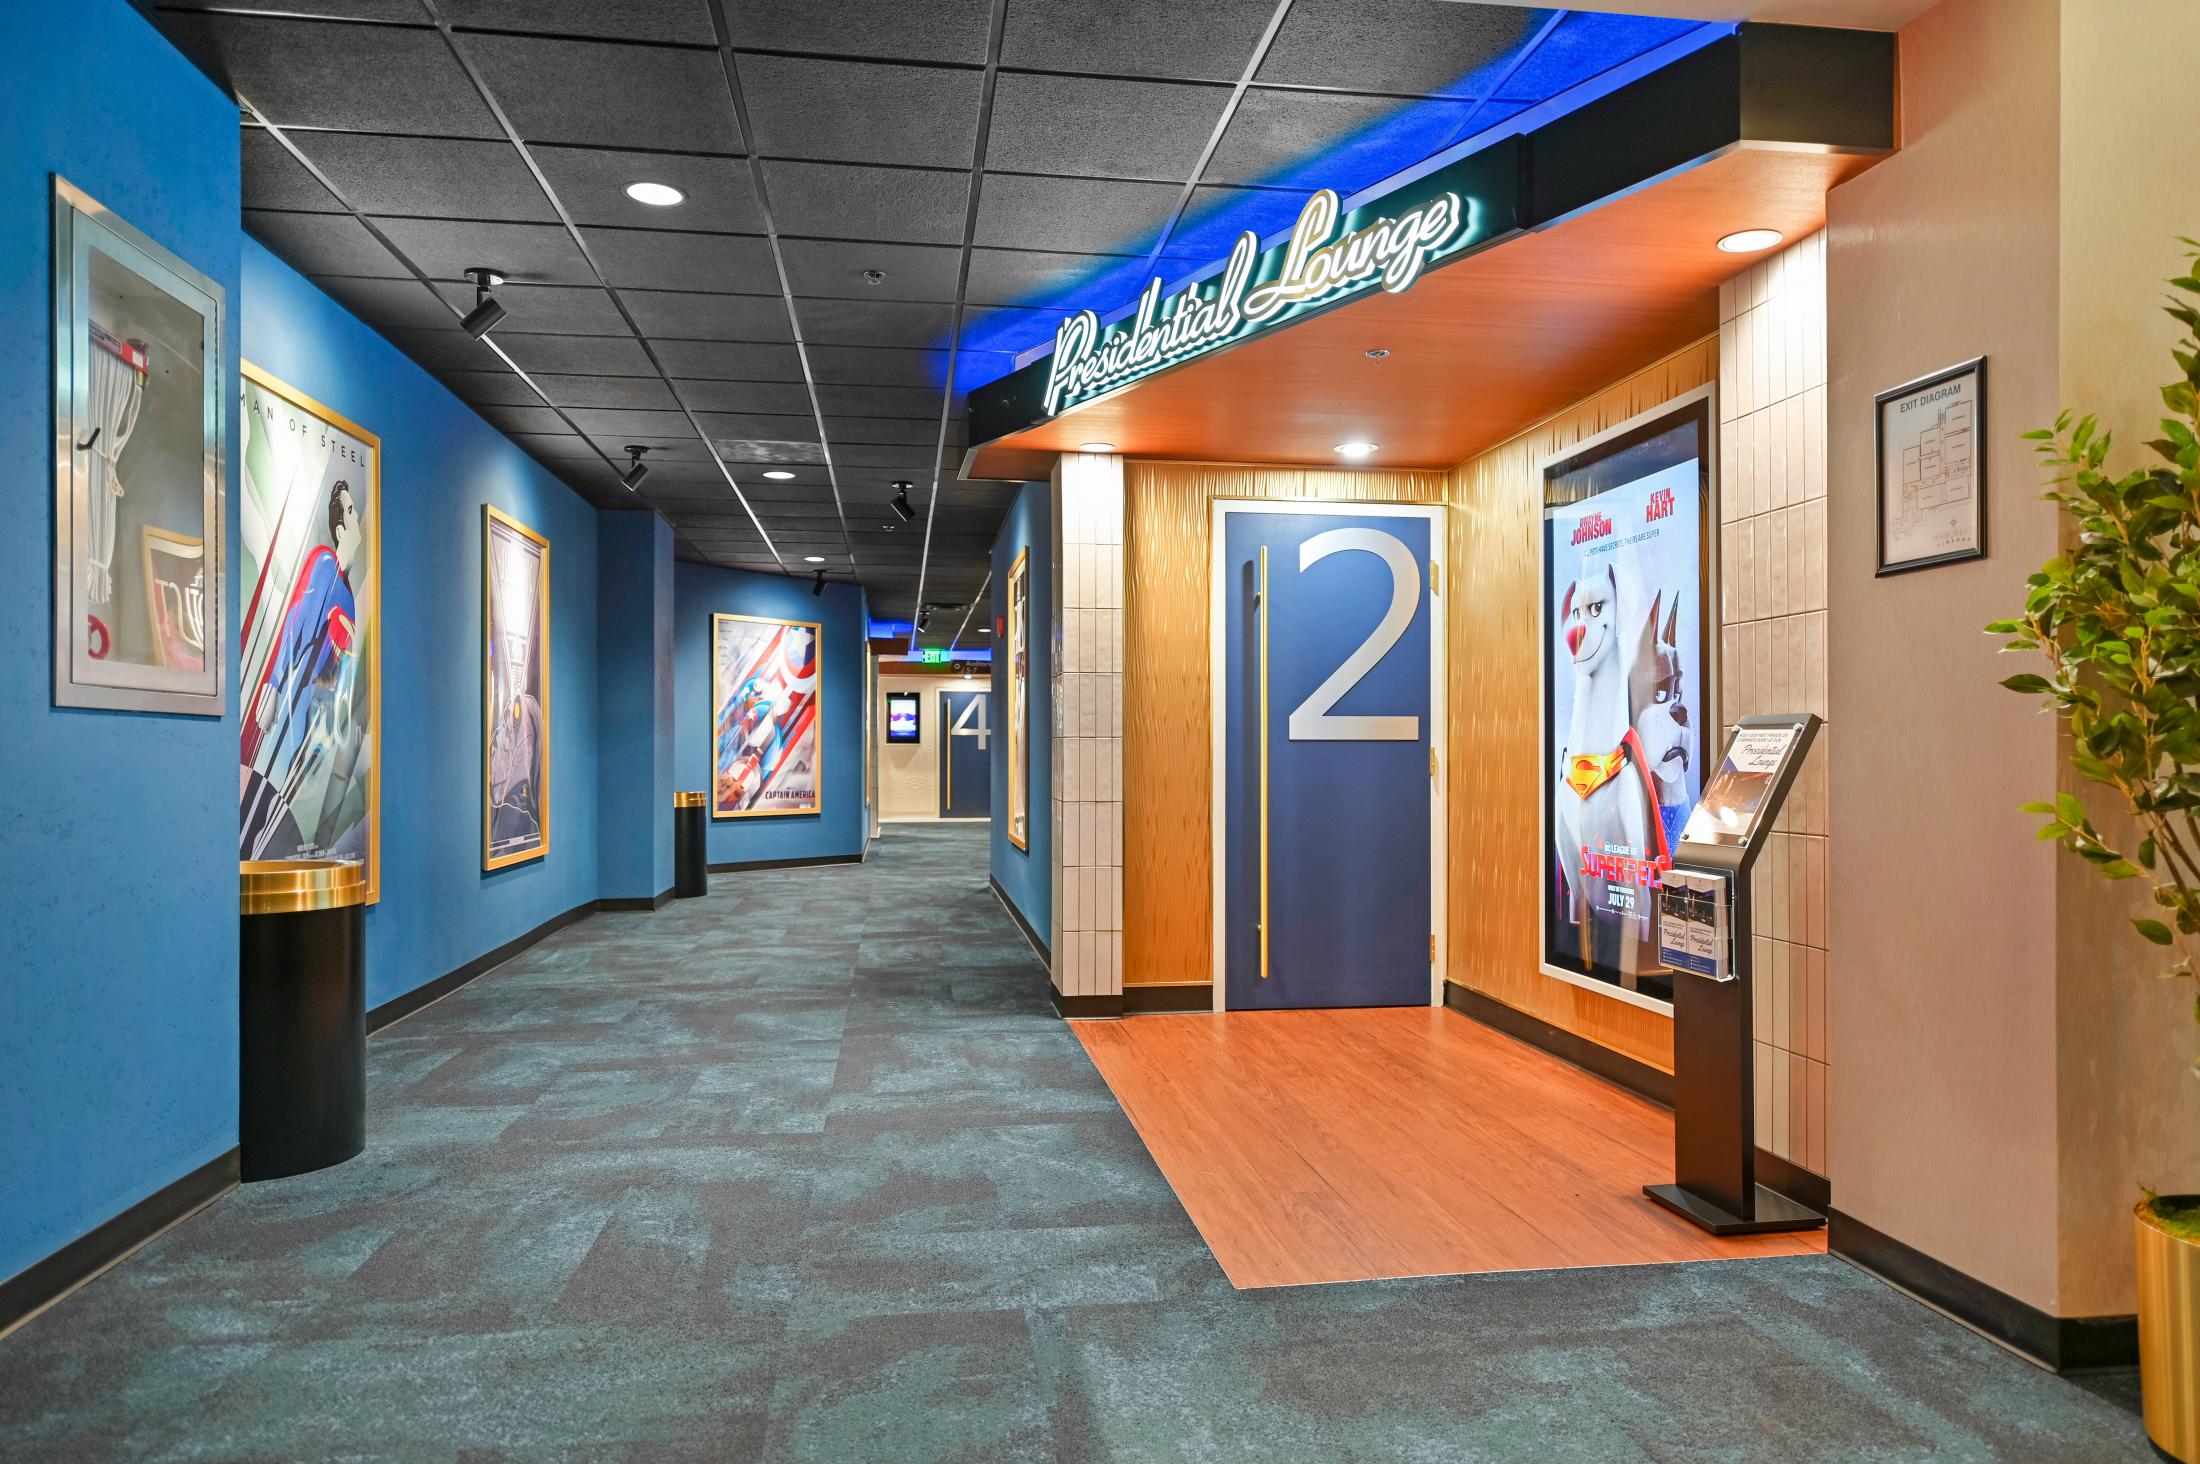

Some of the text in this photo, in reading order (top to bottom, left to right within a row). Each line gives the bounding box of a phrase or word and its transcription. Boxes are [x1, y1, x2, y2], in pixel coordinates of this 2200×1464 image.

[1041, 188, 1462, 416] Presidential Lounge
[1900, 383, 1961, 413] EXIT DIAGRAM
[289, 418, 307, 437] OF
[321, 435, 365, 468] STEEL
[1650, 487, 1671, 504] KEVIN
[1645, 496, 1675, 523] HART
[1570, 518, 1612, 546] JOHNSON
[1289, 528, 1420, 740] 2
[924, 651, 940, 662] EXIT
[951, 694, 992, 749] 4
[765, 790, 816, 800] CAPTAIN AMERICA
[1611, 844, 1631, 855] LEAGUE
[1607, 892, 1635, 909] JULY 29
